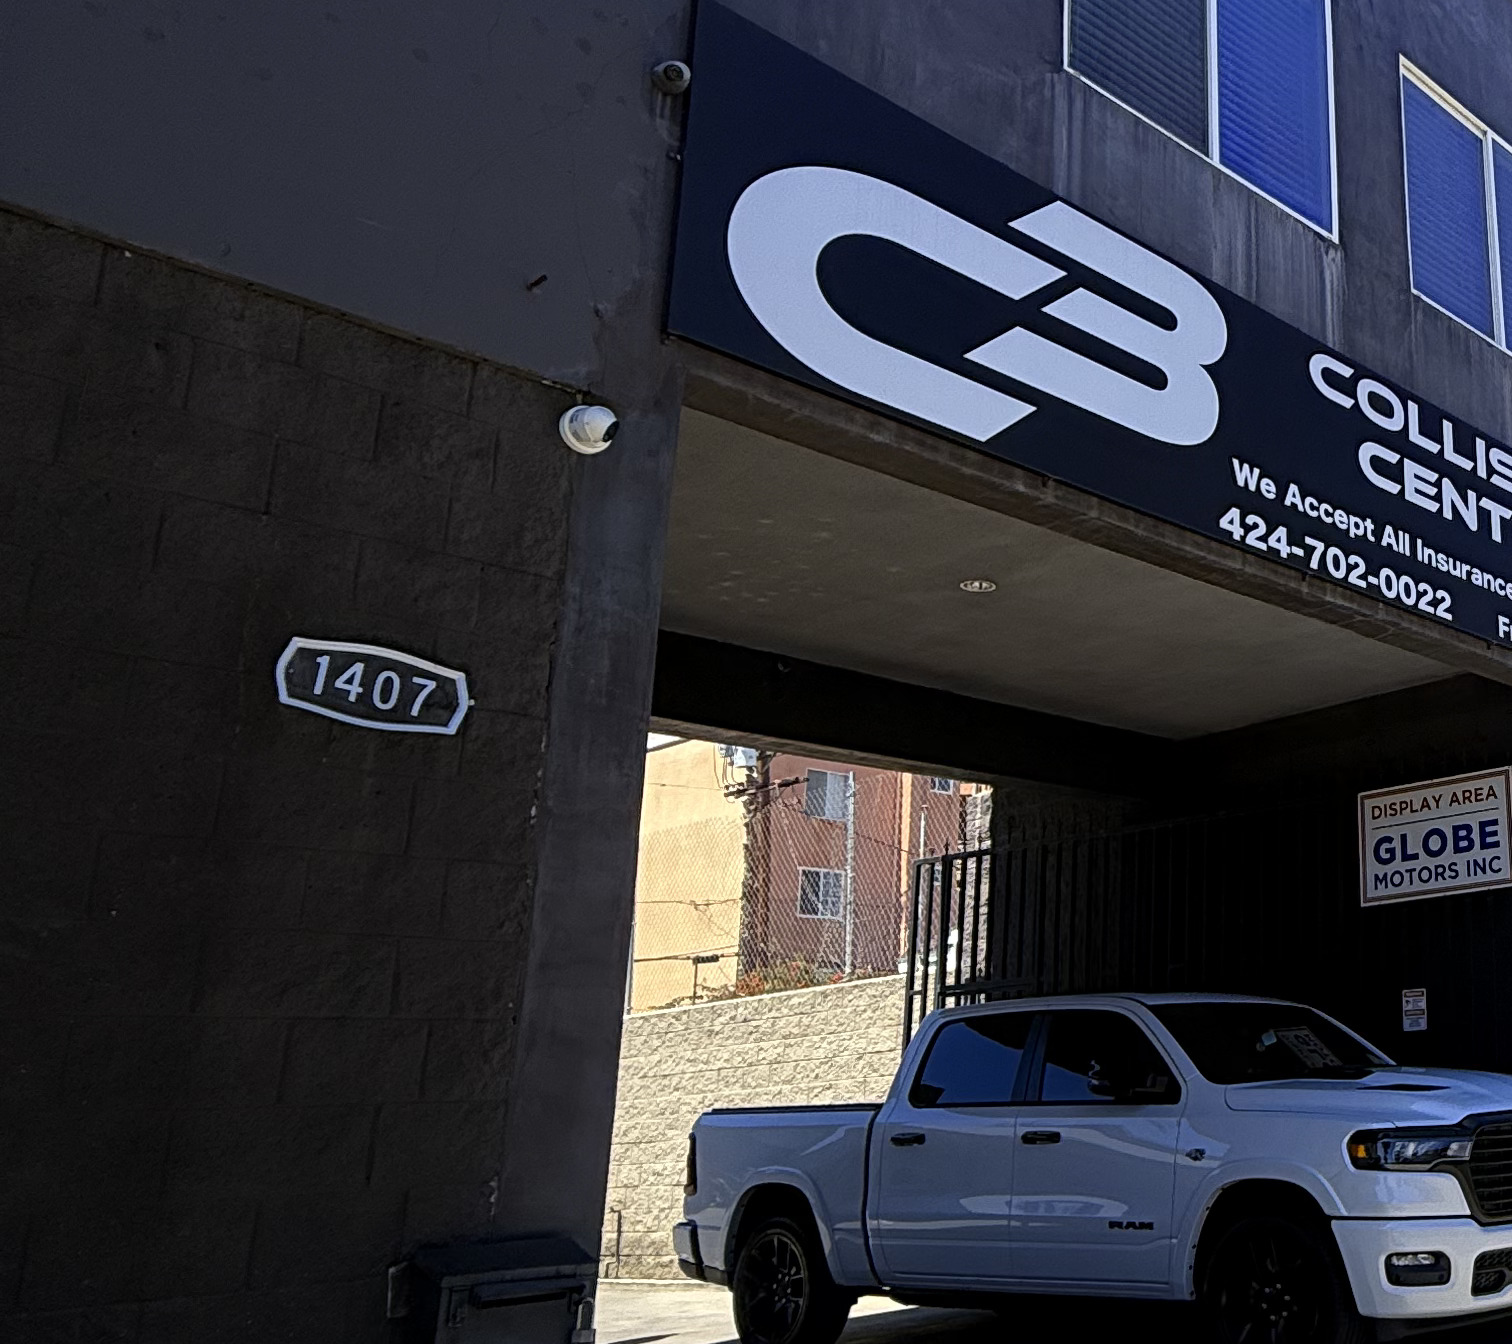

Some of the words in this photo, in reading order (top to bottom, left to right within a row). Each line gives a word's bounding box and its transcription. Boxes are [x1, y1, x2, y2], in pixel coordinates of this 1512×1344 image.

[1232, 458, 1277, 500] We
[1283, 483, 1375, 542] Accept
[1381, 524, 1410, 557] All
[1219, 507, 1453, 621] 424-702-0022
[313, 655, 437, 717] 1407
[1371, 793, 1443, 820] DISPLAY
[1449, 785, 1498, 807] AREA
[1373, 818, 1500, 865] GLOBE
[1374, 861, 1459, 891] MOTORS
[1466, 856, 1502, 877] INC
[1108, 1220, 1154, 1230] RAM
